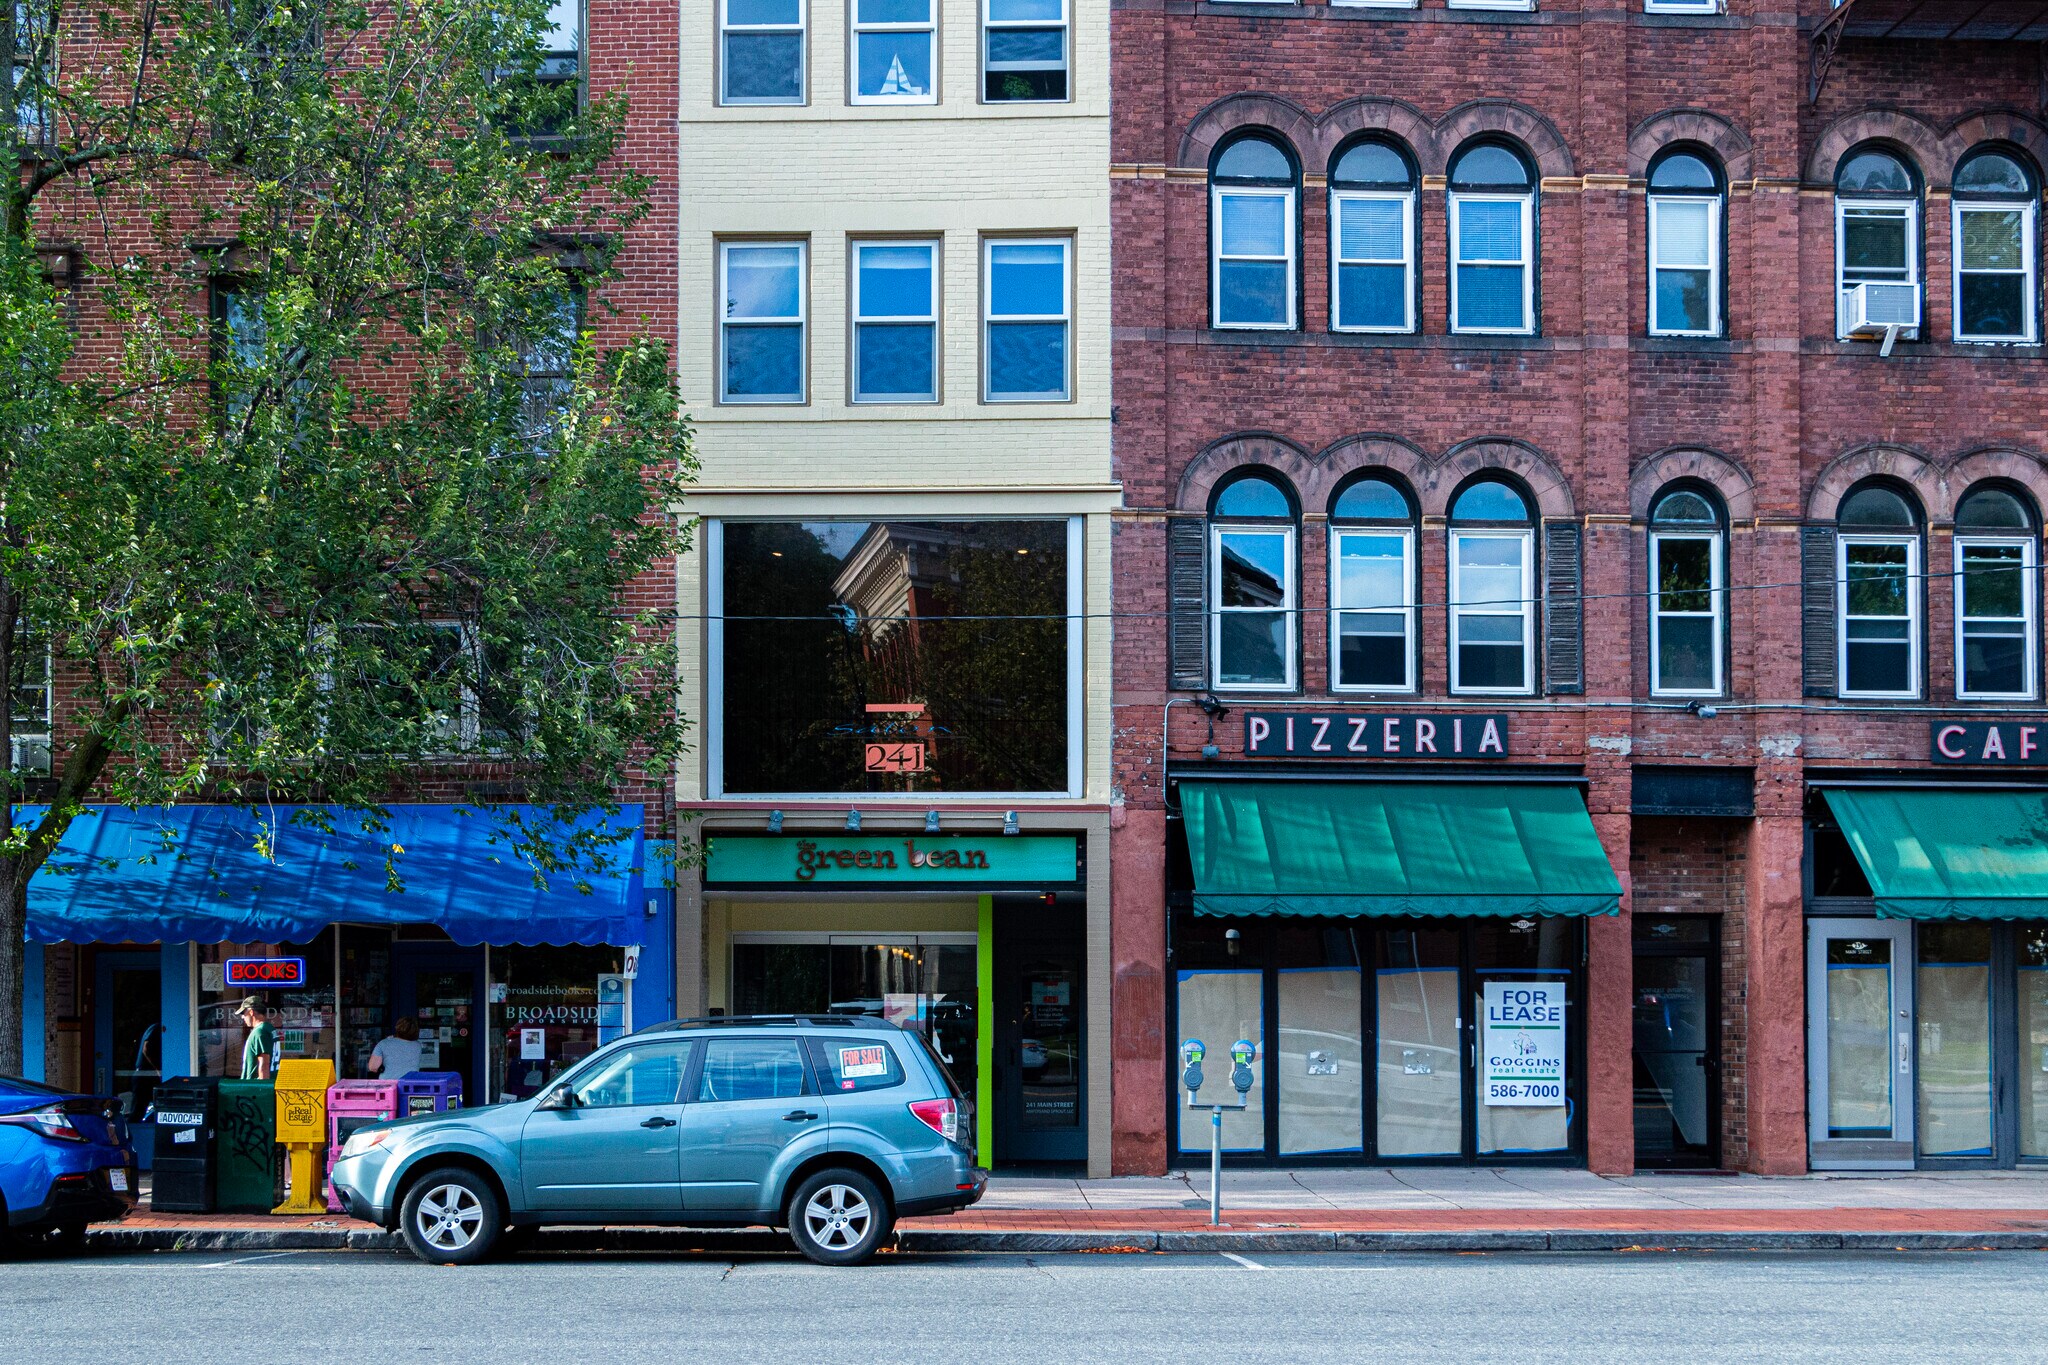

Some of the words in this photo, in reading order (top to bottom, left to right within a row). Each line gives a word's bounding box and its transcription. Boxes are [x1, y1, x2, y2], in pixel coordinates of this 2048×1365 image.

[1249, 716, 1504, 753] PIZZERIA
[1937, 724, 2037, 759] CAF
[866, 743, 923, 771] 241
[796, 839, 817, 850] the
[796, 849, 898, 881] green
[903, 839, 990, 869] bean
[231, 963, 298, 979] BOOKS
[1503, 990, 1547, 1005] FOR
[1490, 1006, 1560, 1022] LEASE
[285, 1031, 303, 1041] ANTI
[843, 1050, 860, 1066] FOR
[861, 1048, 883, 1064] SALE
[1490, 1056, 1560, 1067] GOGGINS
[1493, 1066, 1514, 1074] real
[1521, 1066, 1557, 1074] estate
[1490, 1084, 1560, 1098] 586-7000
[294, 1105, 312, 1114] Real
[162, 1112, 202, 1125] ADVOCATE
[288, 1113, 313, 1122] Estate
